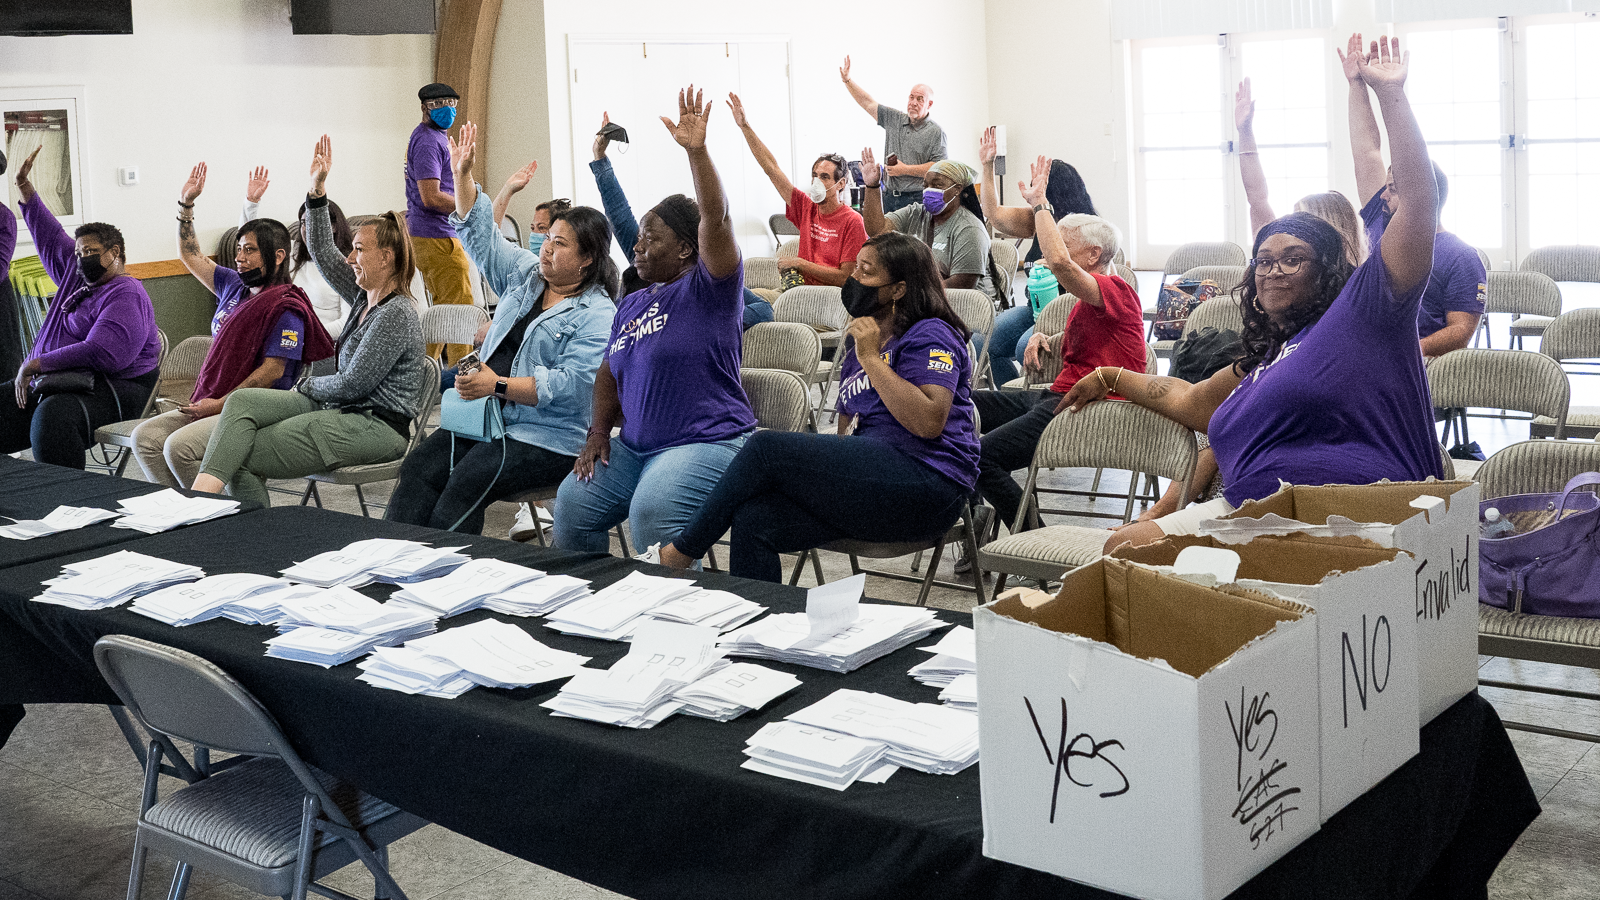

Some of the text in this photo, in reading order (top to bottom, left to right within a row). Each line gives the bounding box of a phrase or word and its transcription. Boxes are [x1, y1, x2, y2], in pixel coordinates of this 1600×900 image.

[630, 313, 669, 346] TIME!
[927, 361, 954, 371] SEIU
[1342, 613, 1391, 729] NO
[1023, 695, 1130, 824] Yes
[1224, 686, 1278, 792] Yes
